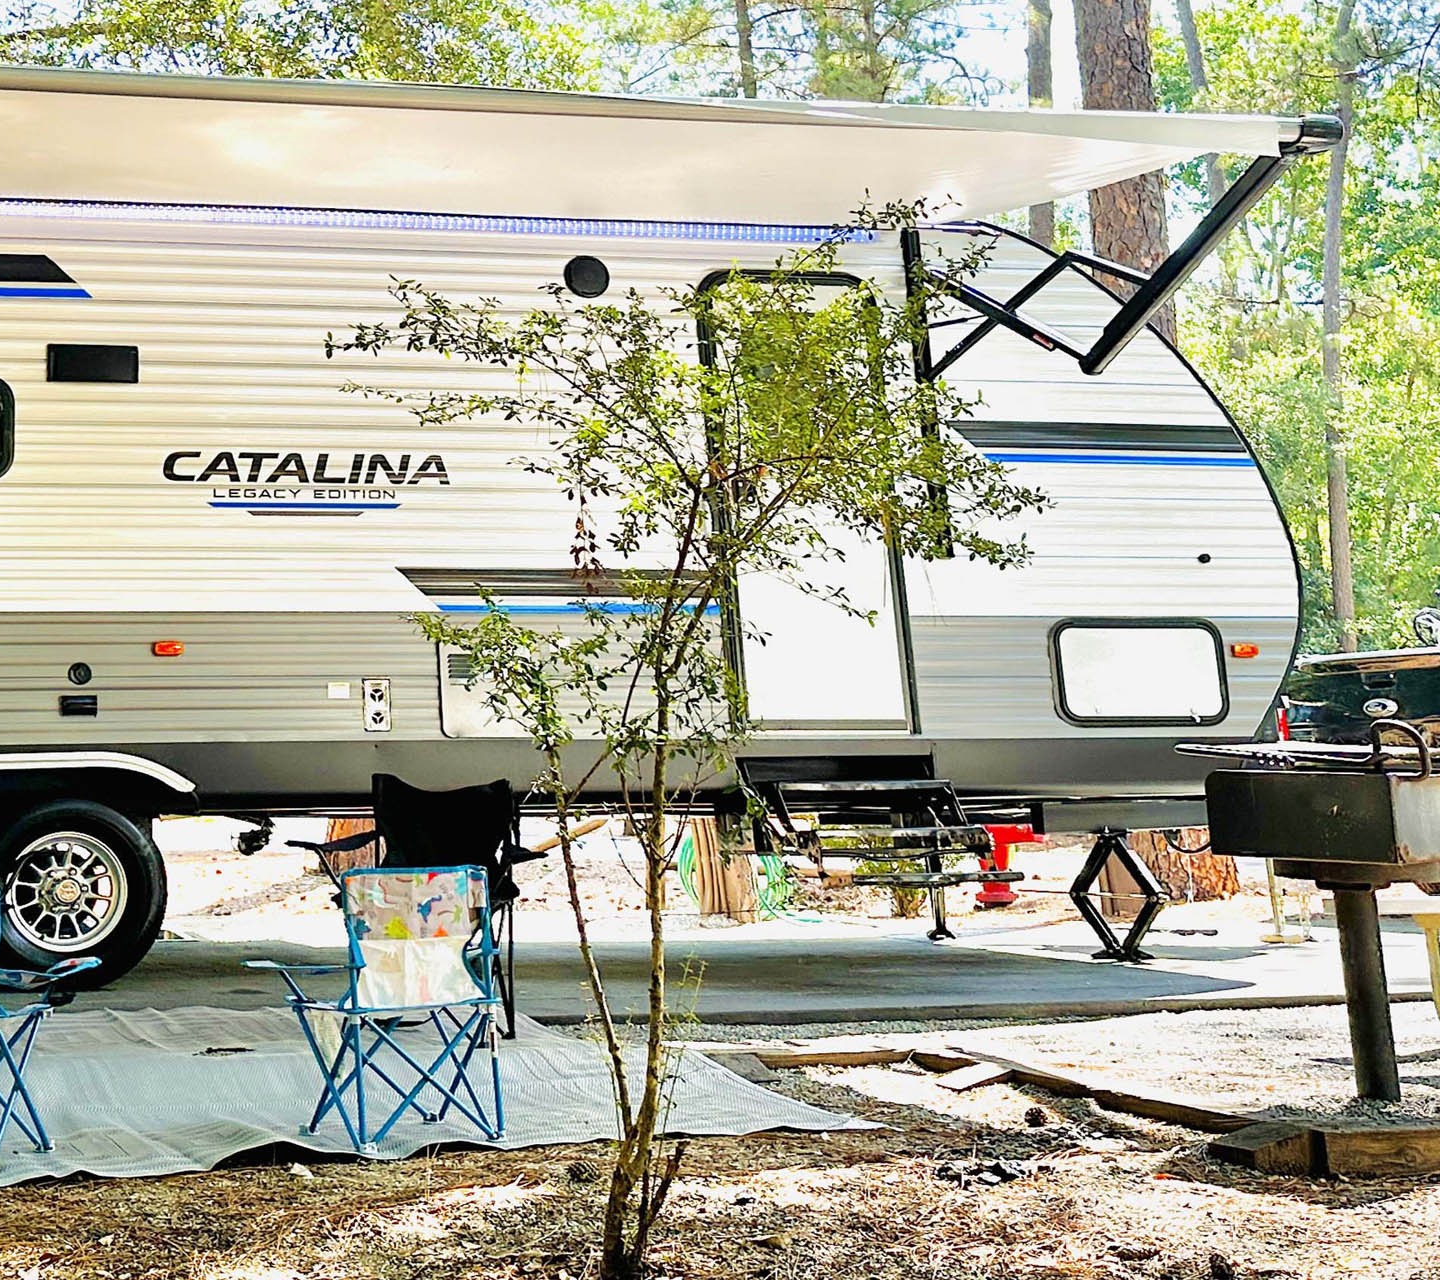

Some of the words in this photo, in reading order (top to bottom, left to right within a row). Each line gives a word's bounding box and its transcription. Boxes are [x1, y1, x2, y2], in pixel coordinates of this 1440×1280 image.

[163, 451, 451, 485] CATALINA
[212, 488, 301, 499] LEGACY
[313, 490, 396, 500] EDITION
